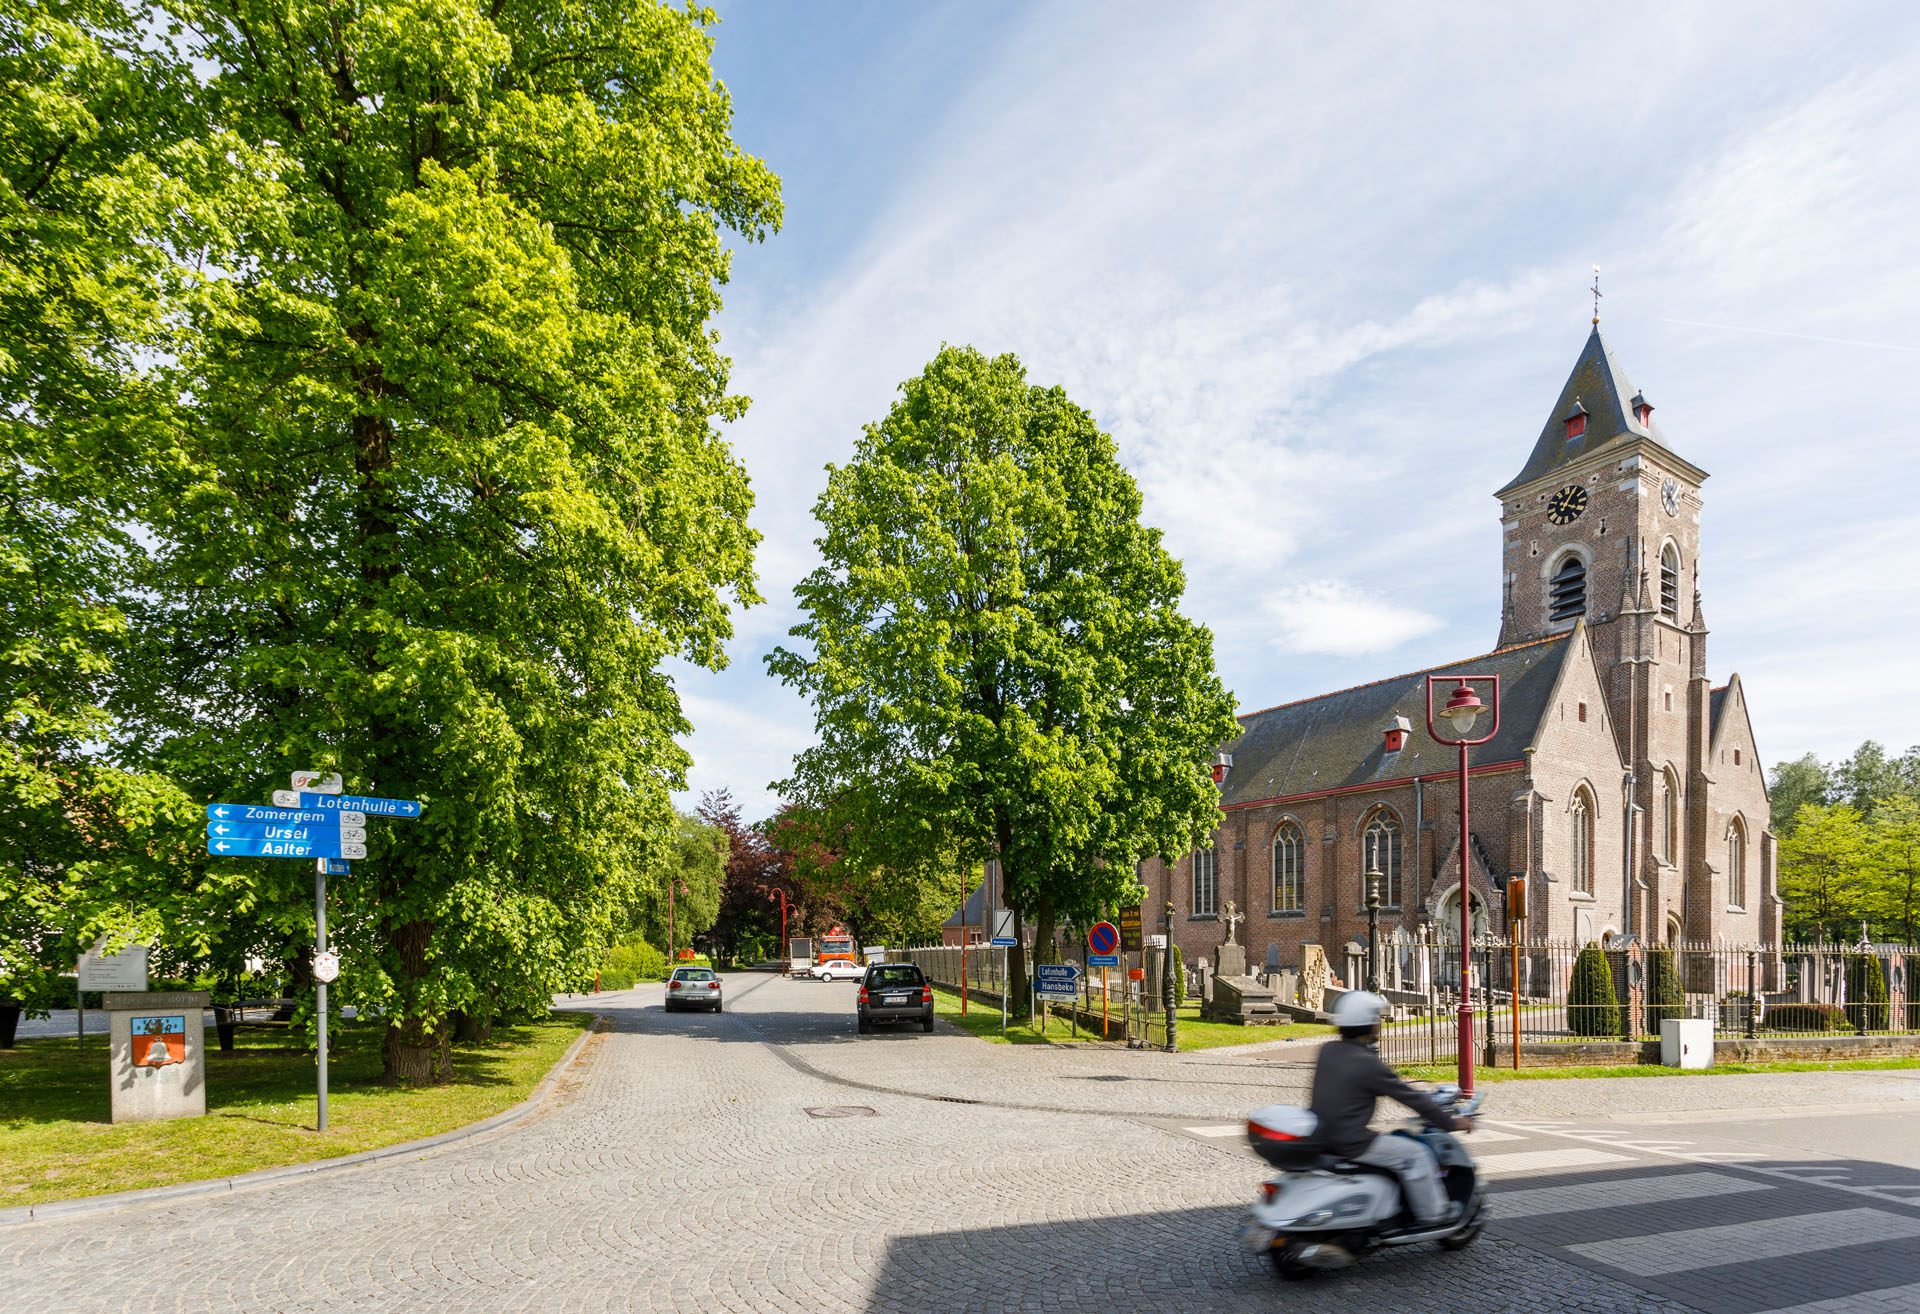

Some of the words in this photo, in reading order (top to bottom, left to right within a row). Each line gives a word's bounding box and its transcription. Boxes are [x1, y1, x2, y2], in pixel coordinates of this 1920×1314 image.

[317, 796, 396, 813] Lotenhulle
[245, 807, 325, 823] Zomergem
[264, 826, 308, 839] Ursel
[261, 842, 313, 856] Aalter
[1041, 967, 1068, 976] Lotenhulle
[1042, 982, 1074, 992] Hansbeke
